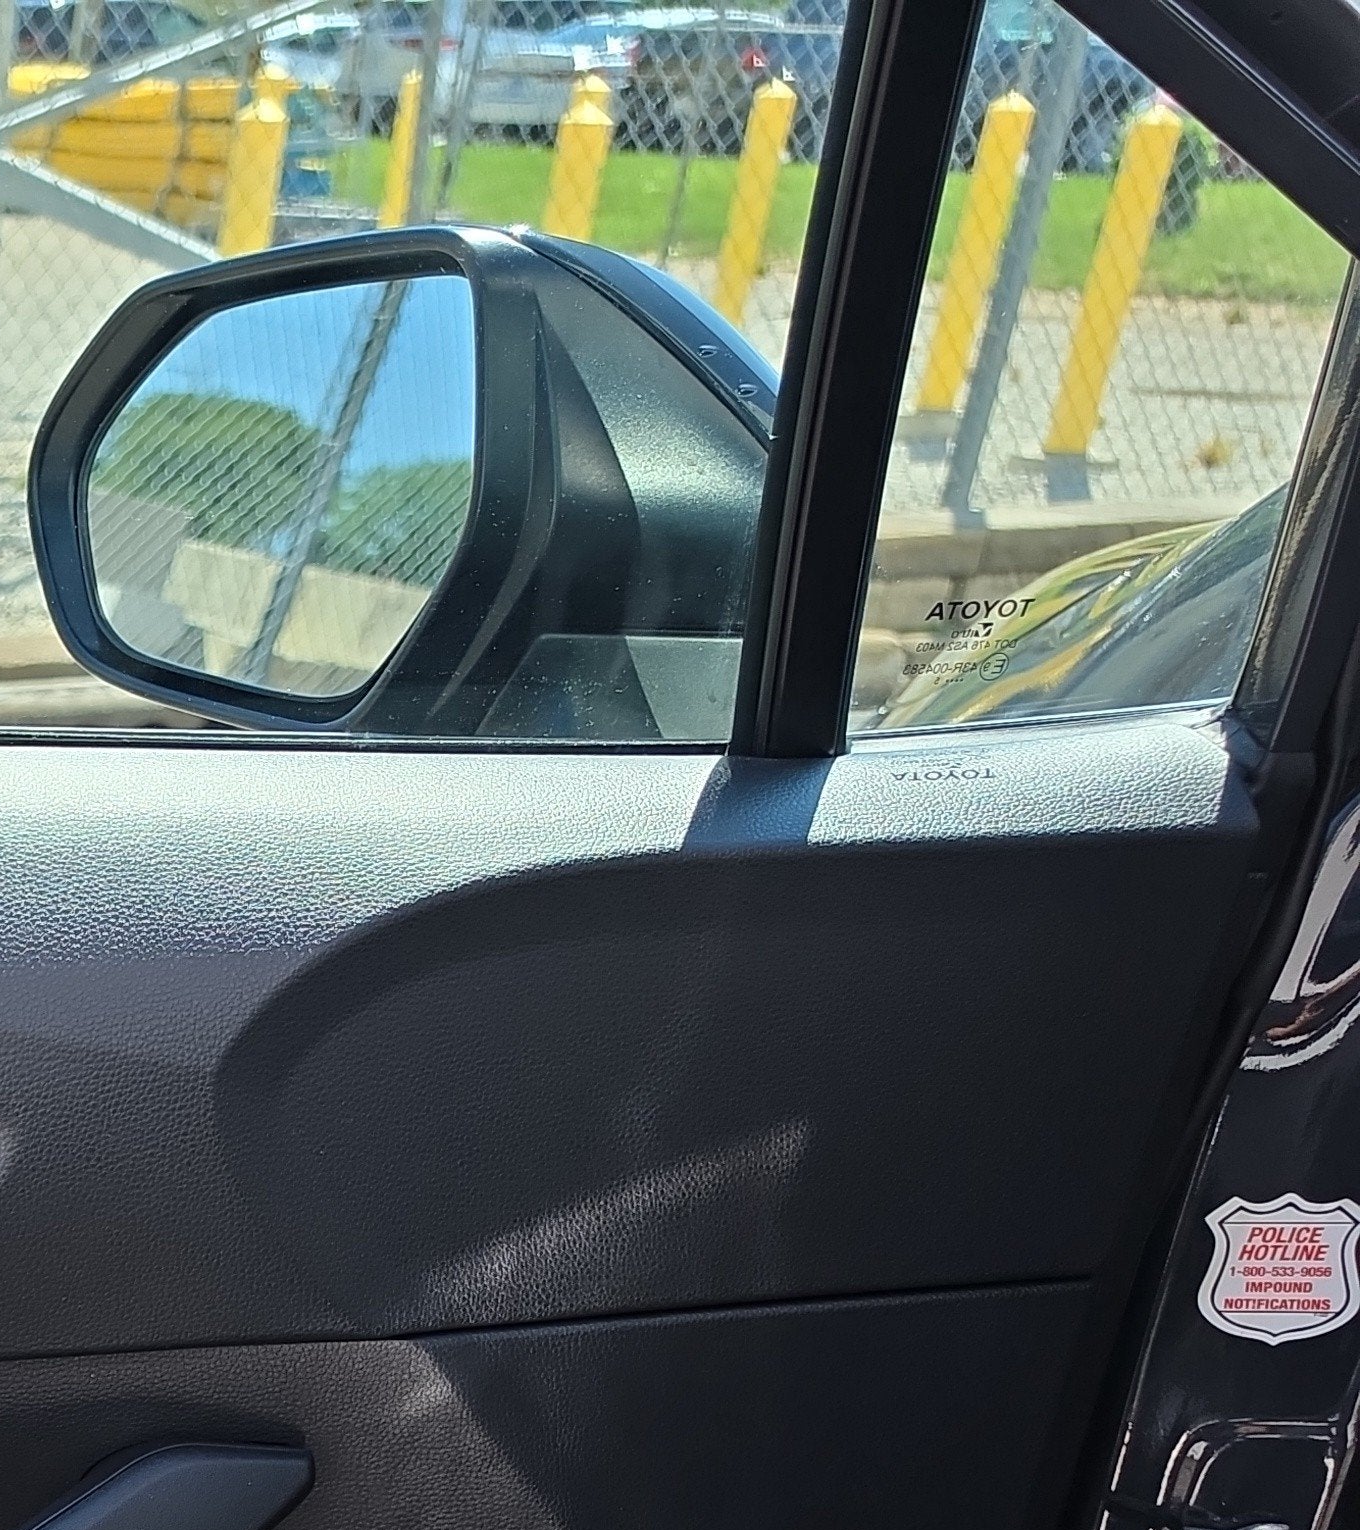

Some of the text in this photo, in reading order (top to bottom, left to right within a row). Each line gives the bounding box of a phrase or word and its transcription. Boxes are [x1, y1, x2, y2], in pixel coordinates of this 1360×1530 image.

[891, 768, 996, 781] TOYOTA
[1247, 1227, 1325, 1243] POLICE
[1238, 1245, 1329, 1261] HOTLINE
[1230, 1266, 1332, 1277] 1-800-533-9056
[1245, 1282, 1313, 1293] IMPOUND
[1224, 1298, 1331, 1310] NOTIFICATIONS
